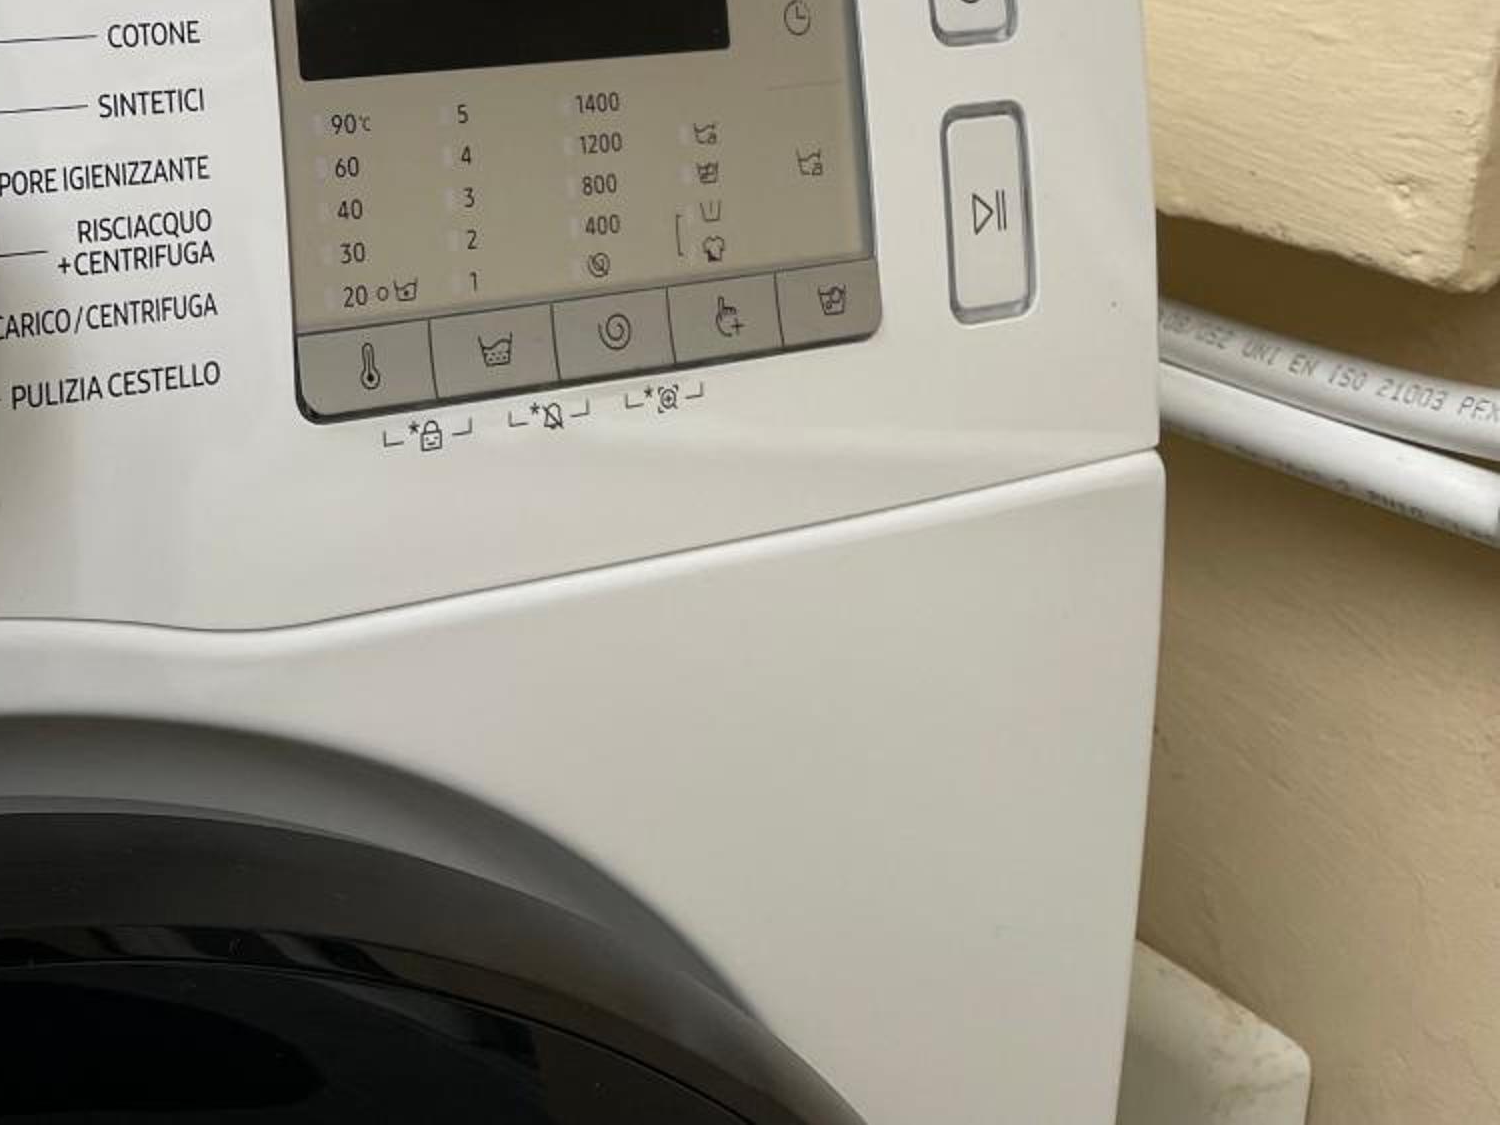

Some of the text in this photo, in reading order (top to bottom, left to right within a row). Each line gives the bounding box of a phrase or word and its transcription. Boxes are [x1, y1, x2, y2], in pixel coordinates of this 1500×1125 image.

[107, 20, 200, 48] COTONE
[98, 88, 205, 118] SINTETICI
[457, 104, 469, 124] 5
[575, 91, 620, 114] 1400
[579, 132, 623, 155] 1200
[334, 156, 360, 178] 60
[460, 146, 472, 166] 4
[63, 155, 210, 192] IGIENIZZANTE
[582, 173, 617, 196] 800
[337, 198, 363, 220] 40
[463, 187, 475, 208] 3
[77, 208, 212, 244] RISCIACQUO
[585, 214, 621, 236] 400
[467, 229, 478, 250] 2
[340, 242, 366, 264] 30
[469, 271, 478, 292] 1
[343, 285, 368, 308] 20
[11, 360, 220, 410] PULIZIA CESTELLO
[1288, 353, 1318, 378] EN
[1327, 363, 1368, 391] ISO
[1375, 378, 1449, 411] 21003
